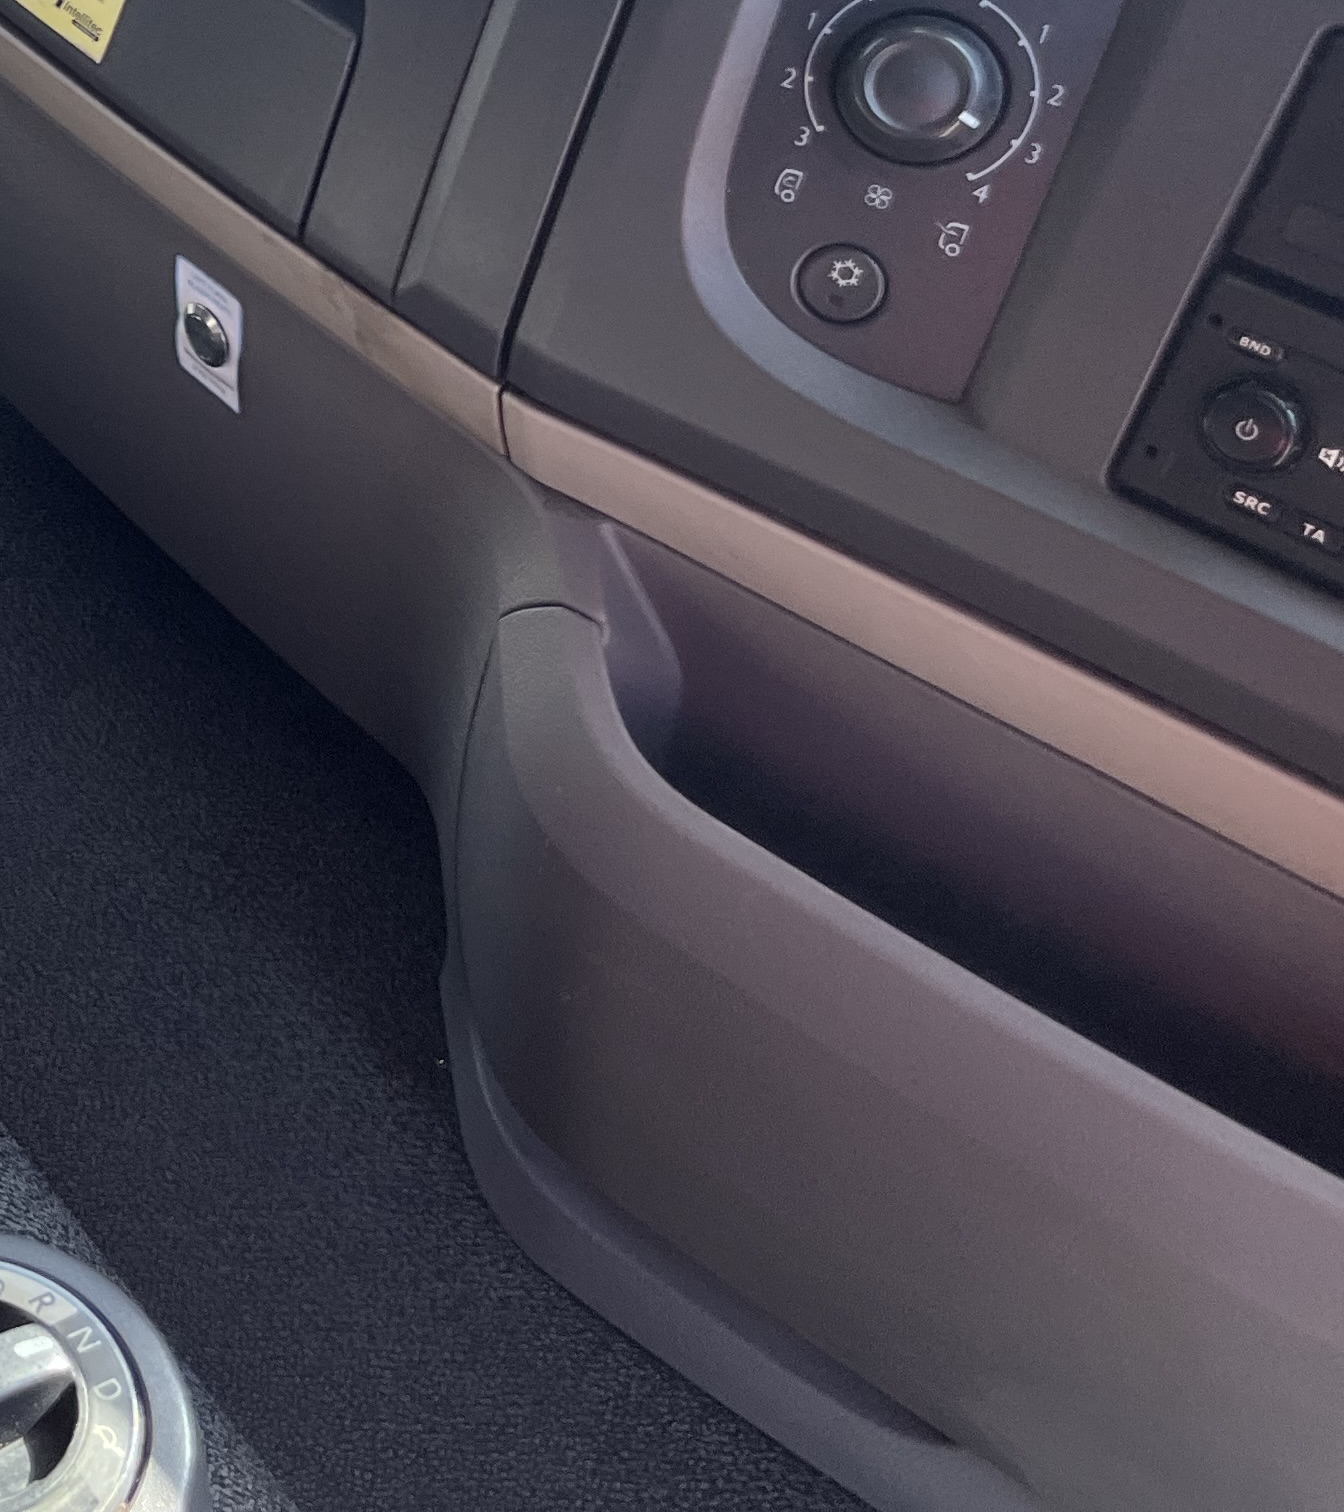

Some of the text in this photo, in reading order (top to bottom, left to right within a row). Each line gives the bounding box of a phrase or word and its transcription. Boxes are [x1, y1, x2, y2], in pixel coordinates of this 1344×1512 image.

[780, 67, 1064, 107] 2 2
[793, 126, 1042, 164] 3 3
[971, 184, 990, 204] 4
[1238, 336, 1272, 356] BND
[1232, 490, 1326, 544] SRC TA
[28, 1291, 122, 1401] R N D
